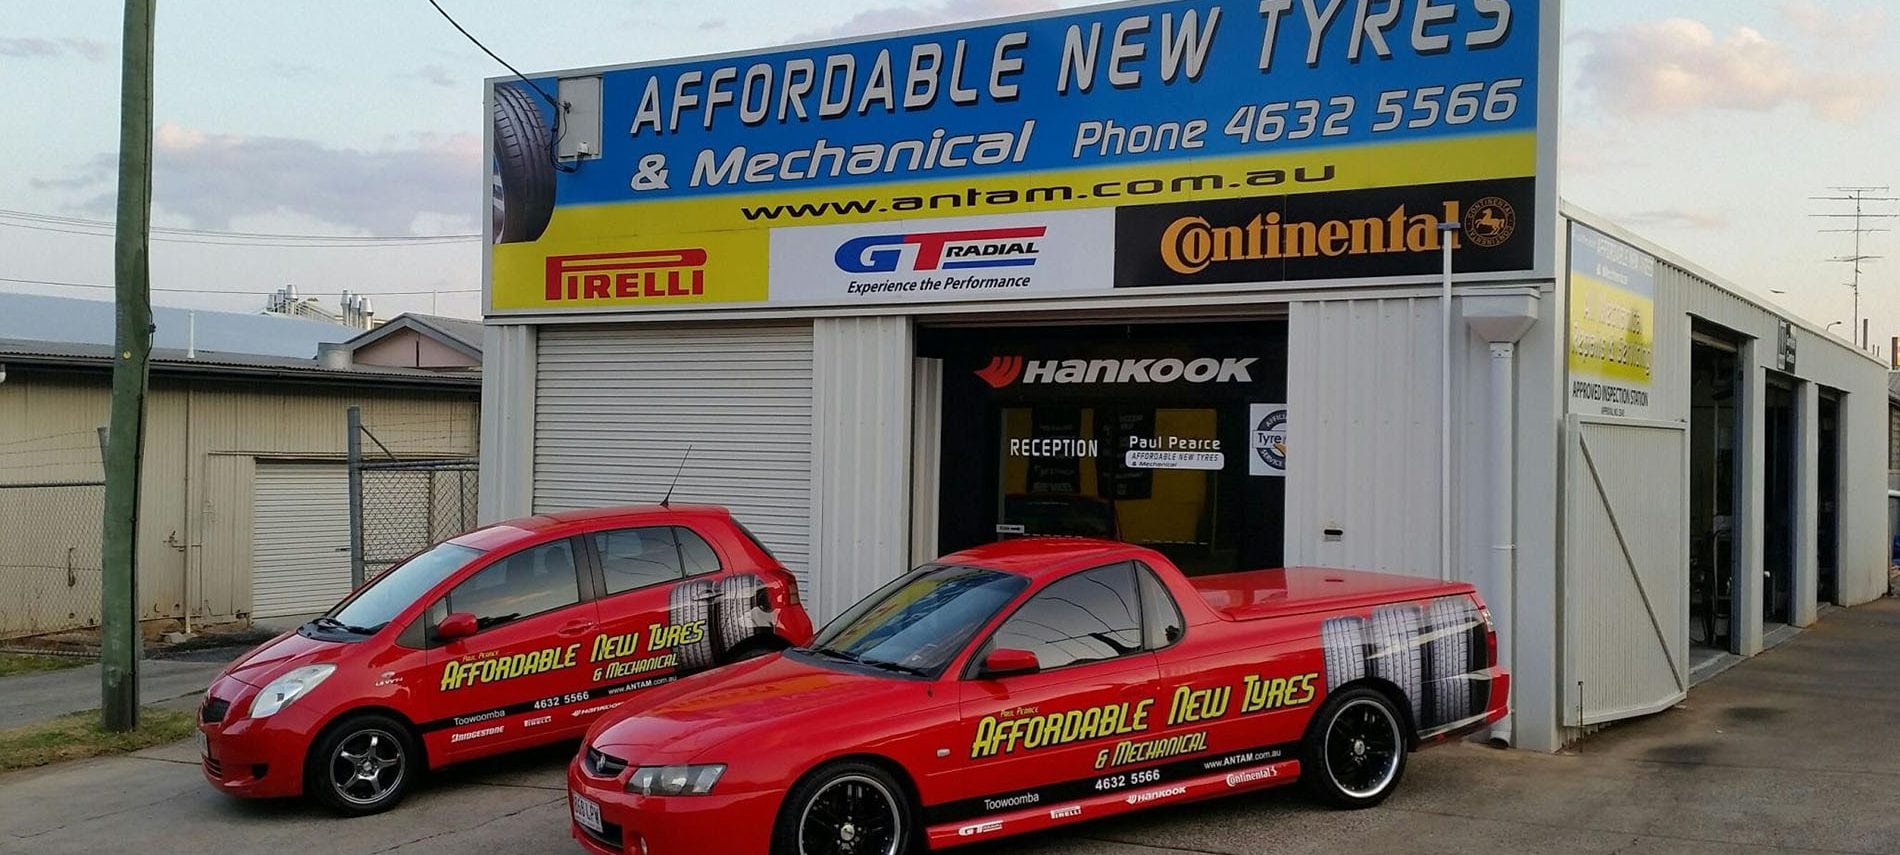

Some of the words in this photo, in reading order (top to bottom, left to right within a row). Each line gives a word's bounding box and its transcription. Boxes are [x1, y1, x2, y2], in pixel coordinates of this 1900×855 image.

[629, 32, 1029, 136] AFFORDABLE
[1057, 7, 1222, 94] NEW
[1258, 0, 1513, 72] TYRES
[630, 153, 670, 192] &
[689, 120, 1037, 188] Mechanical
[1073, 118, 1209, 159] Phone
[1223, 96, 1355, 145] 4632
[1372, 78, 1524, 133] 5566
[741, 164, 1336, 221] www.antam.com.au
[1160, 200, 1462, 275] Continental
[946, 242, 1039, 258] RADIAL
[545, 248, 708, 301] PIRELLI
[847, 280, 917, 297] Experience
[919, 276, 942, 291] the
[943, 275, 1031, 290] Performance
[1572, 381, 1601, 401] APPROVED
[1601, 385, 1630, 405] INSPECTION
[1630, 389, 1649, 407] STATION
[1010, 438, 1098, 458] RECEPTION
[1129, 435, 1161, 449] Paul
[1168, 436, 1221, 450] Pearce
[1131, 452, 1177, 461] AFFORDABLE
[1179, 453, 1194, 462] NEW
[1197, 453, 1219, 462] TYRES
[440, 643, 580, 692] AFFORDABLE
[591, 632, 639, 662] NEW
[649, 619, 705, 650] TYRES
[593, 668, 602, 682] &
[605, 653, 679, 680] MECHANICAL
[608, 676, 678, 696] www.ANTAM.com.au
[534, 697, 560, 710] 4632
[564, 691, 590, 704] 5566
[453, 709, 506, 726] Toowoomba
[970, 699, 1154, 758] AFFORDABLE
[1168, 686, 1230, 723] NEW
[1242, 673, 1319, 714] TYRES
[451, 725, 505, 743] BRIDGESTONE
[1094, 746, 1107, 769] &
[1110, 731, 1208, 768] MECHANICAL
[1203, 749, 1282, 770] www.ANTAM.com.au
[1095, 776, 1126, 791] 4632
[1130, 769, 1161, 786] 5566
[1226, 767, 1272, 788] Continental
[984, 792, 1040, 811] Toowoomba
[1050, 805, 1082, 819] PIRELLI
